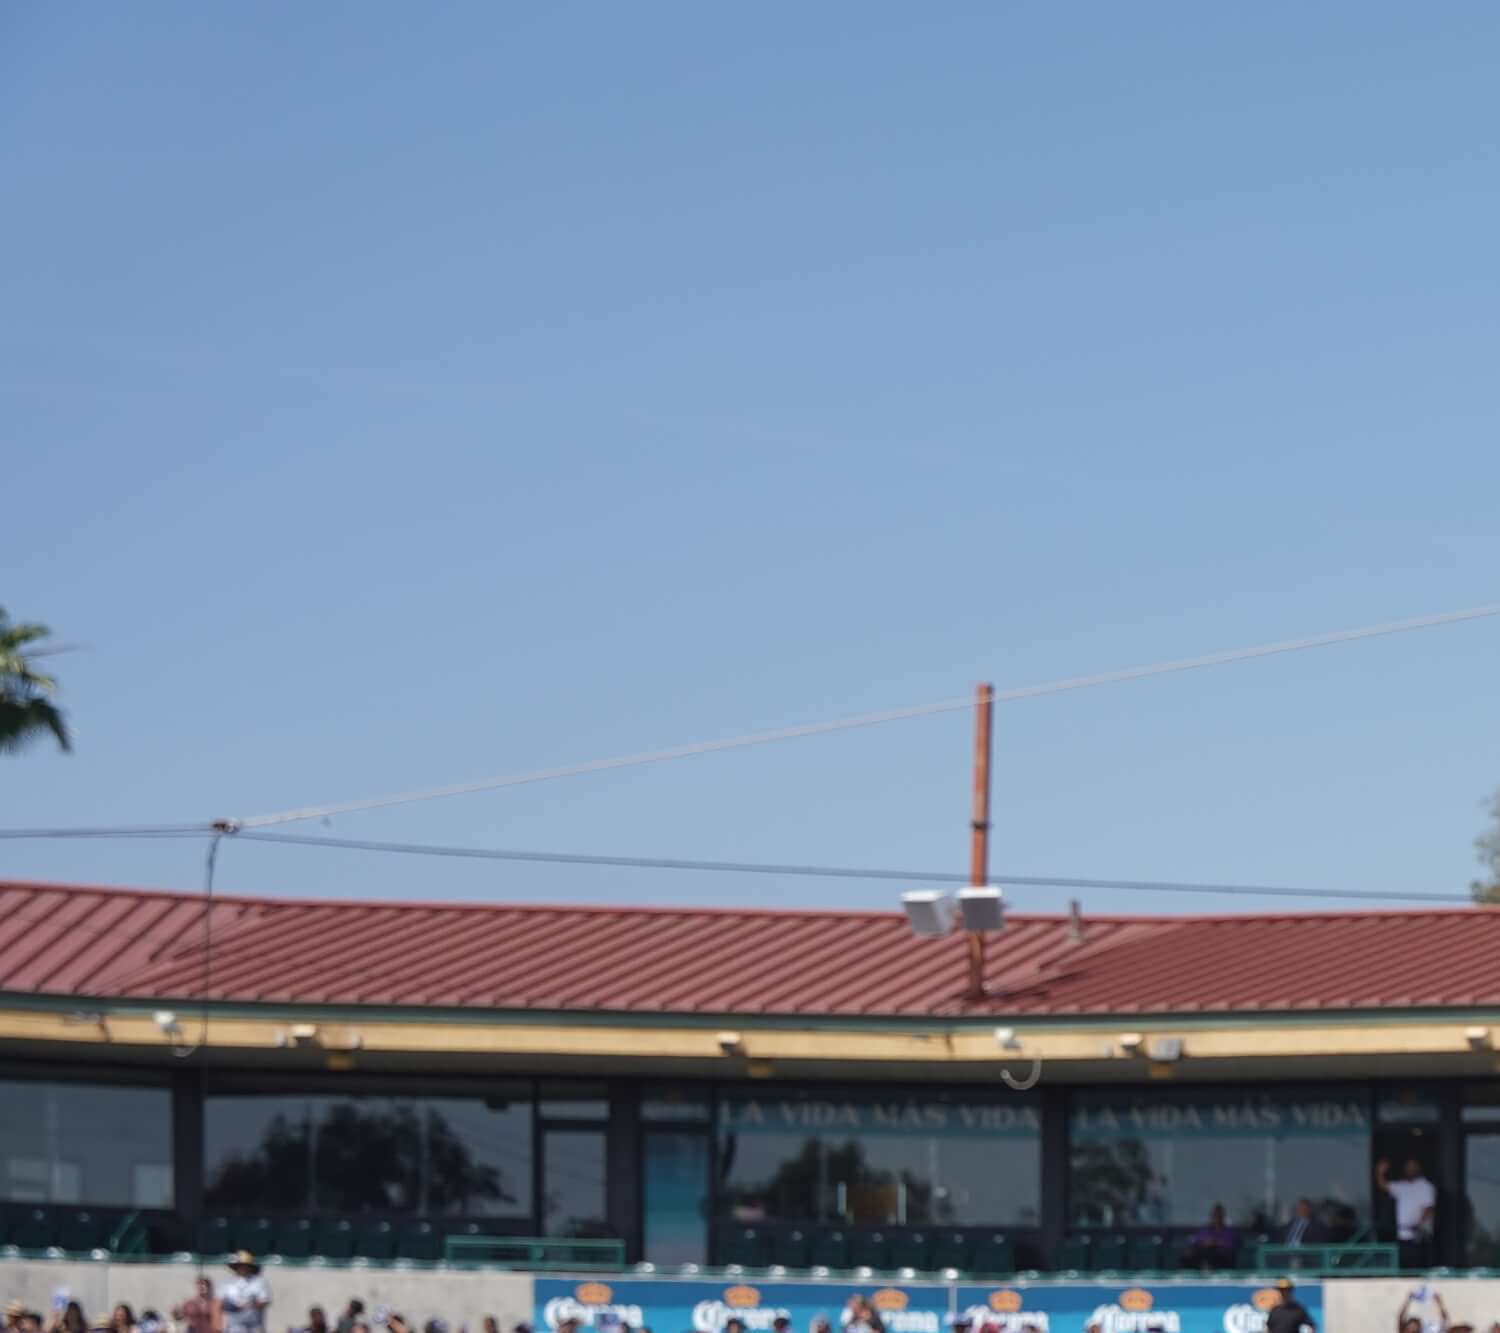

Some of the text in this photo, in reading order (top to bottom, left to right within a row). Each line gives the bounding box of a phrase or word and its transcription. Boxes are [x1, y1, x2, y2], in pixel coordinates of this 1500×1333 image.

[779, 1104, 861, 1128] VIDA
[959, 1104, 1040, 1130] VIDA
[1130, 1104, 1202, 1129] VIDA
[1290, 1103, 1366, 1128] VIDA
